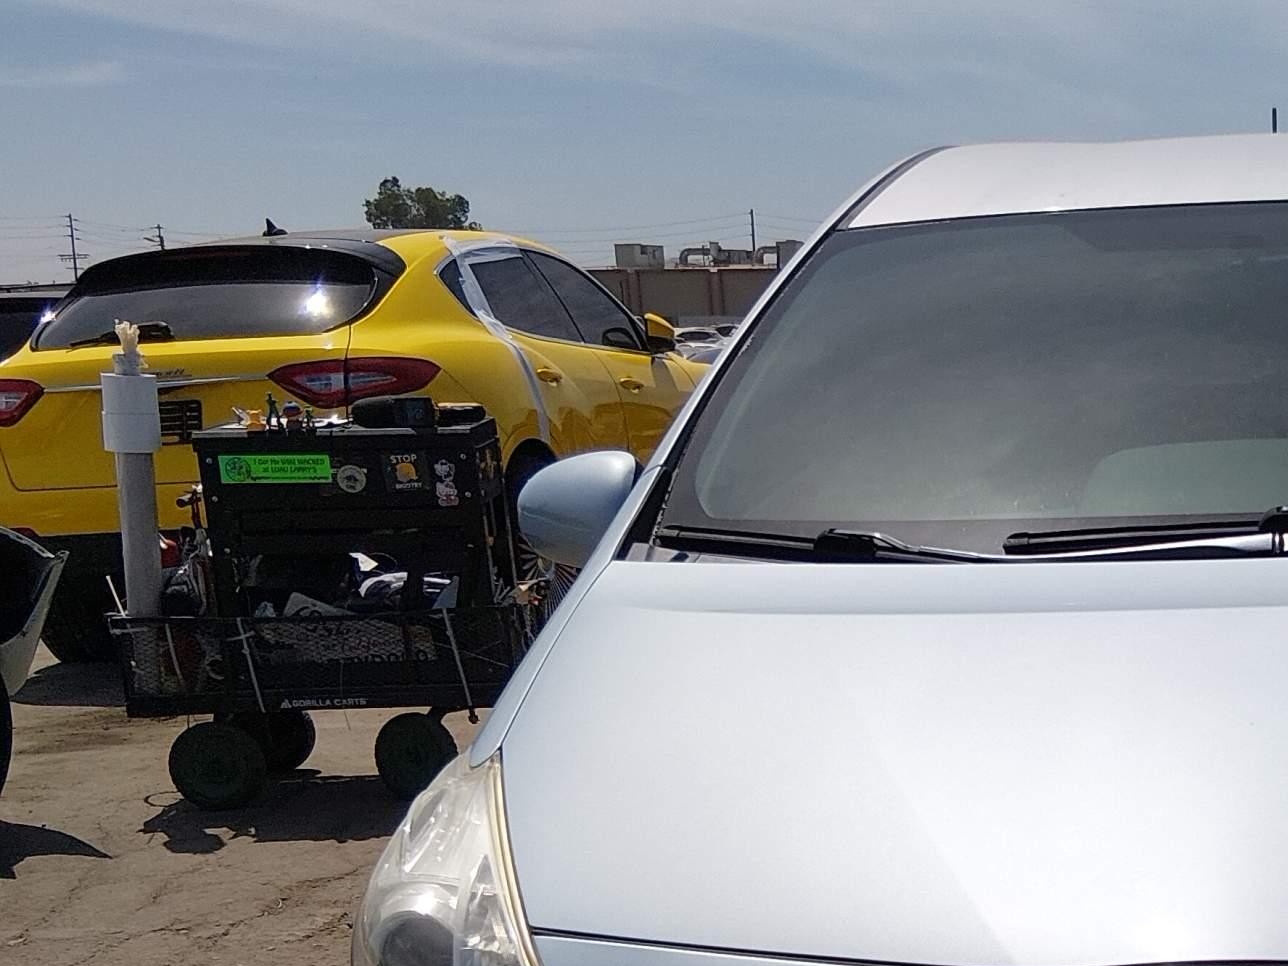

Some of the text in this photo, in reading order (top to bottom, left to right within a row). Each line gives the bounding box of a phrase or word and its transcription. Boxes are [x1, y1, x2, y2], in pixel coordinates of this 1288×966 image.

[389, 454, 418, 464] STOP
[292, 697, 367, 708] GORILLA CARTS
